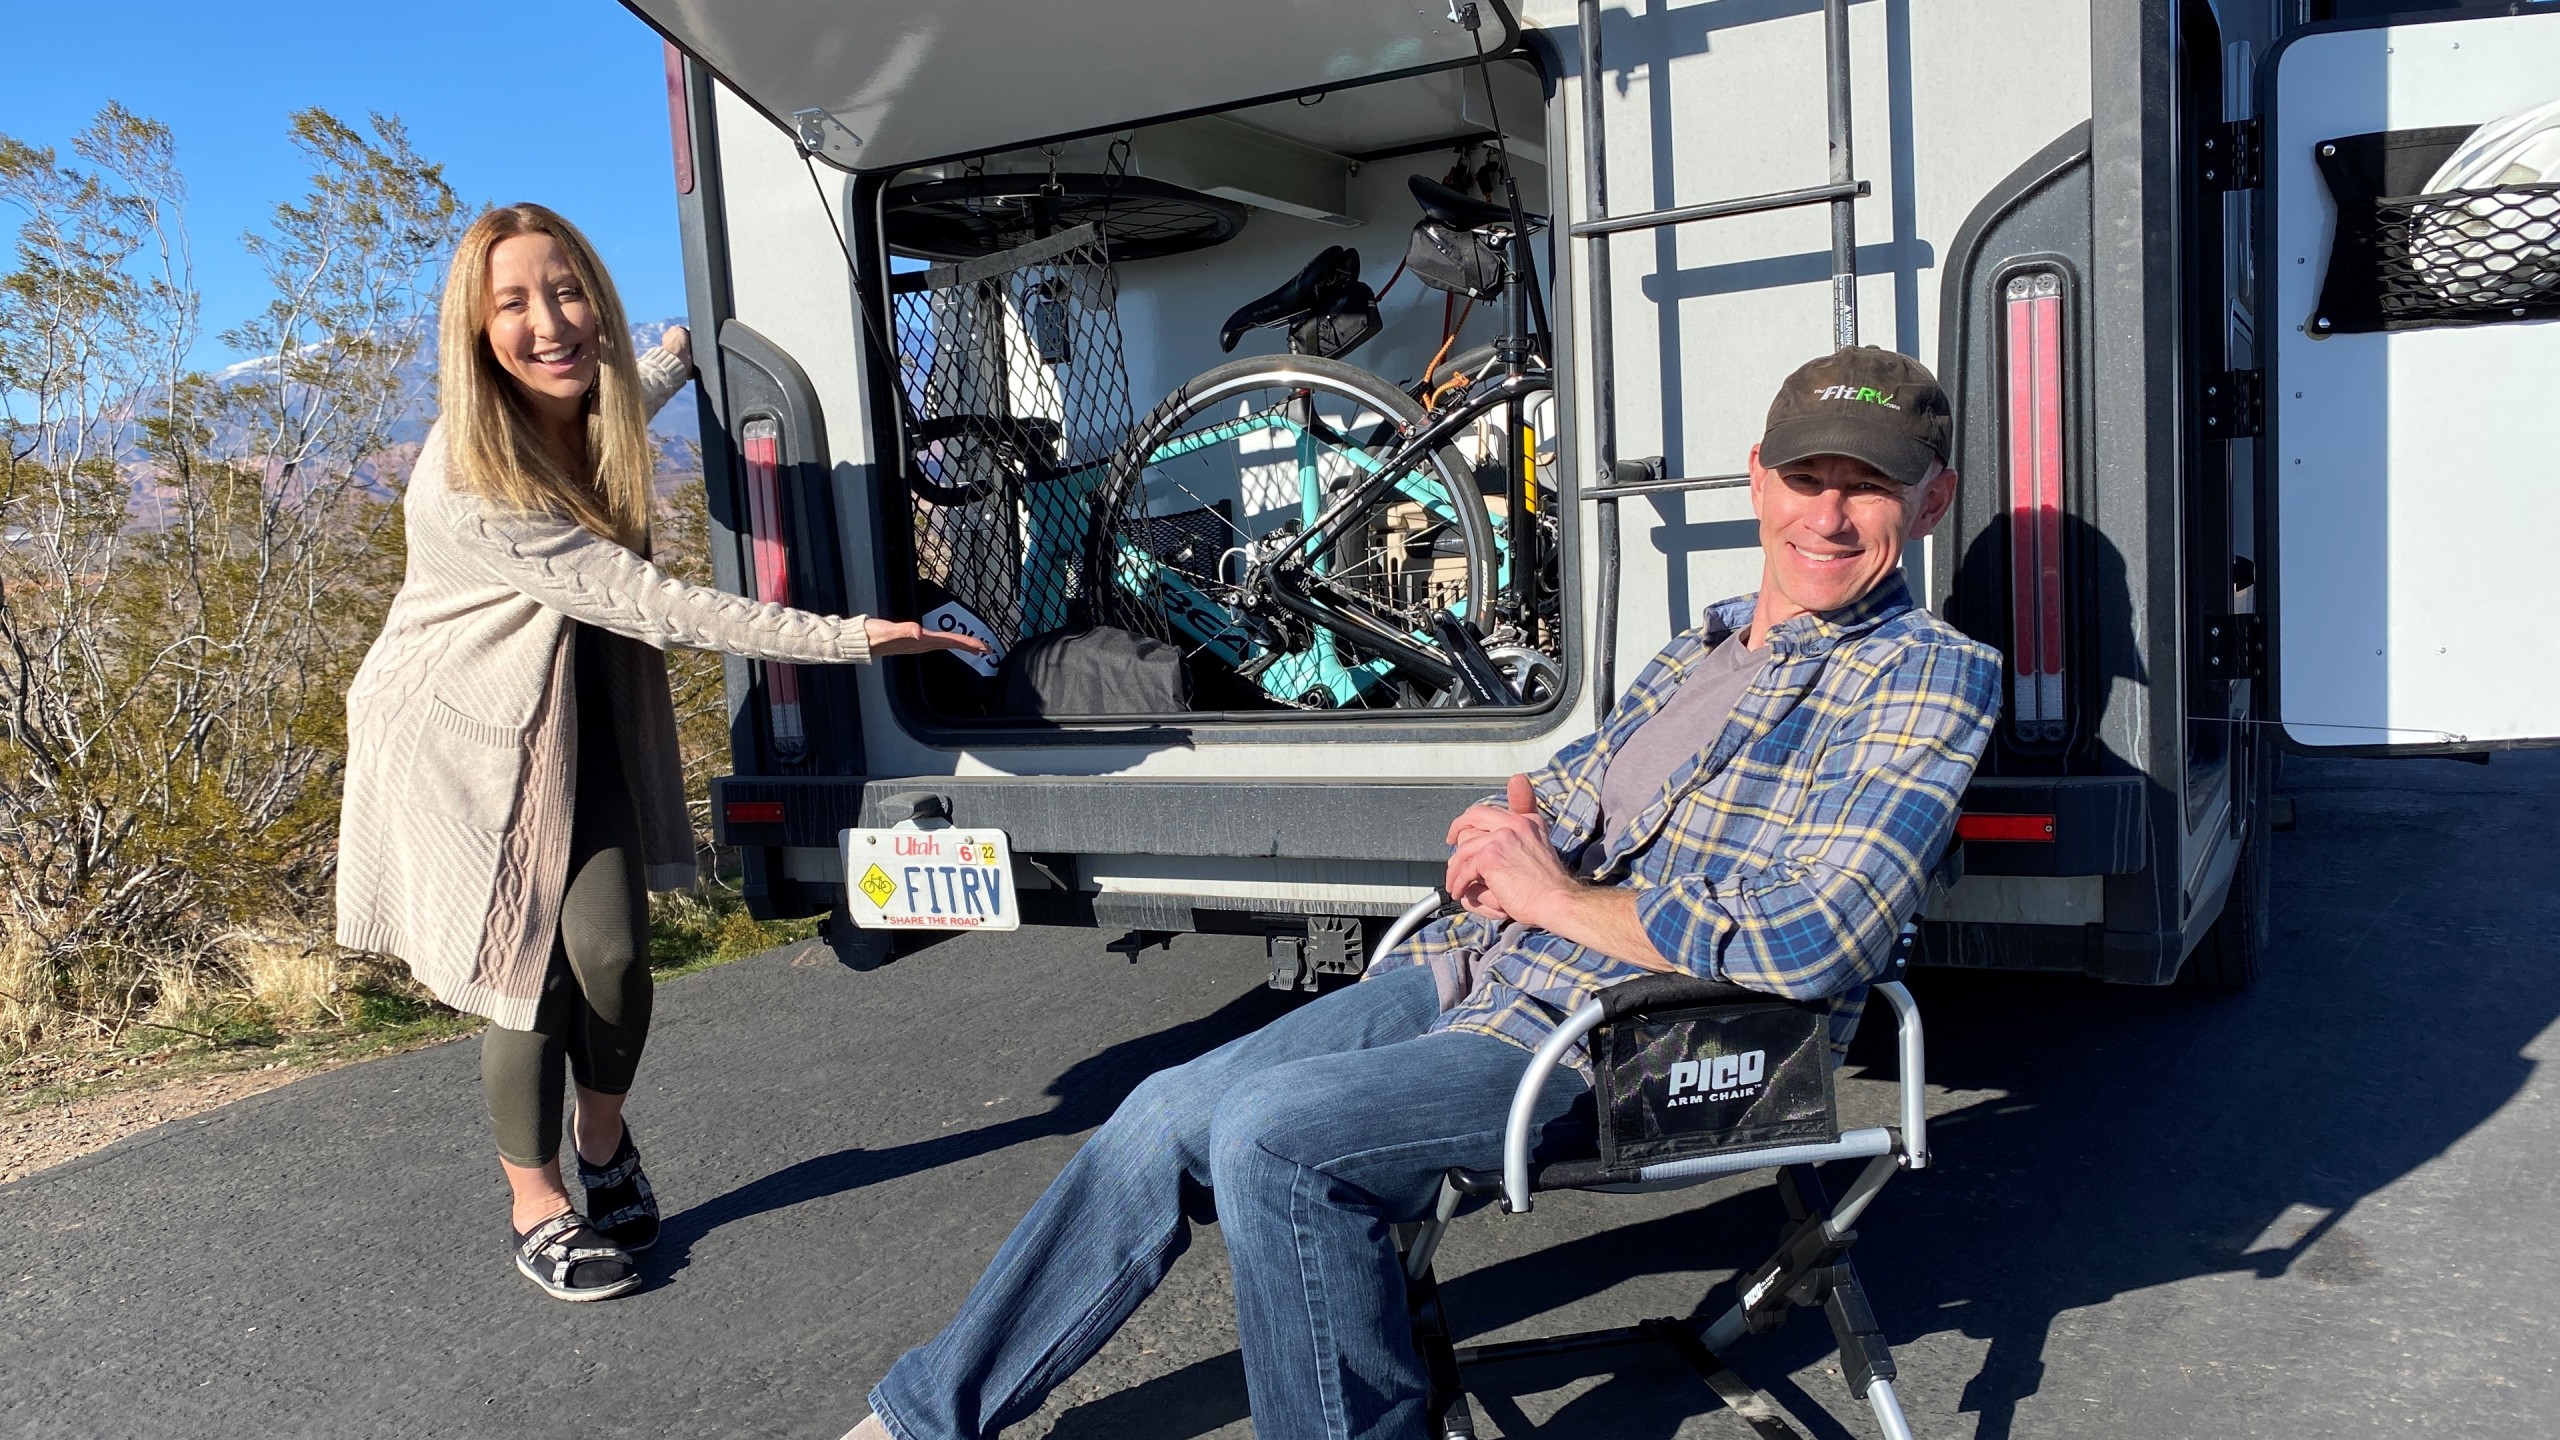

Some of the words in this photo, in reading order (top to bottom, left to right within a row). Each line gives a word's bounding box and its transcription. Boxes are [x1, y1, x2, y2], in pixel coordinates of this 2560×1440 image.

[1148, 582, 1251, 663] BEA
[895, 834, 941, 856] Utah
[959, 845, 973, 862] 6
[981, 846, 996, 859] 22
[903, 866, 1000, 916] FITRV
[889, 916, 924, 925] SHARE
[926, 916, 948, 925] THE
[950, 917, 980, 926] ROAD
[1669, 1049, 1766, 1096] PICO
[1667, 1095, 1703, 1108] ARM
